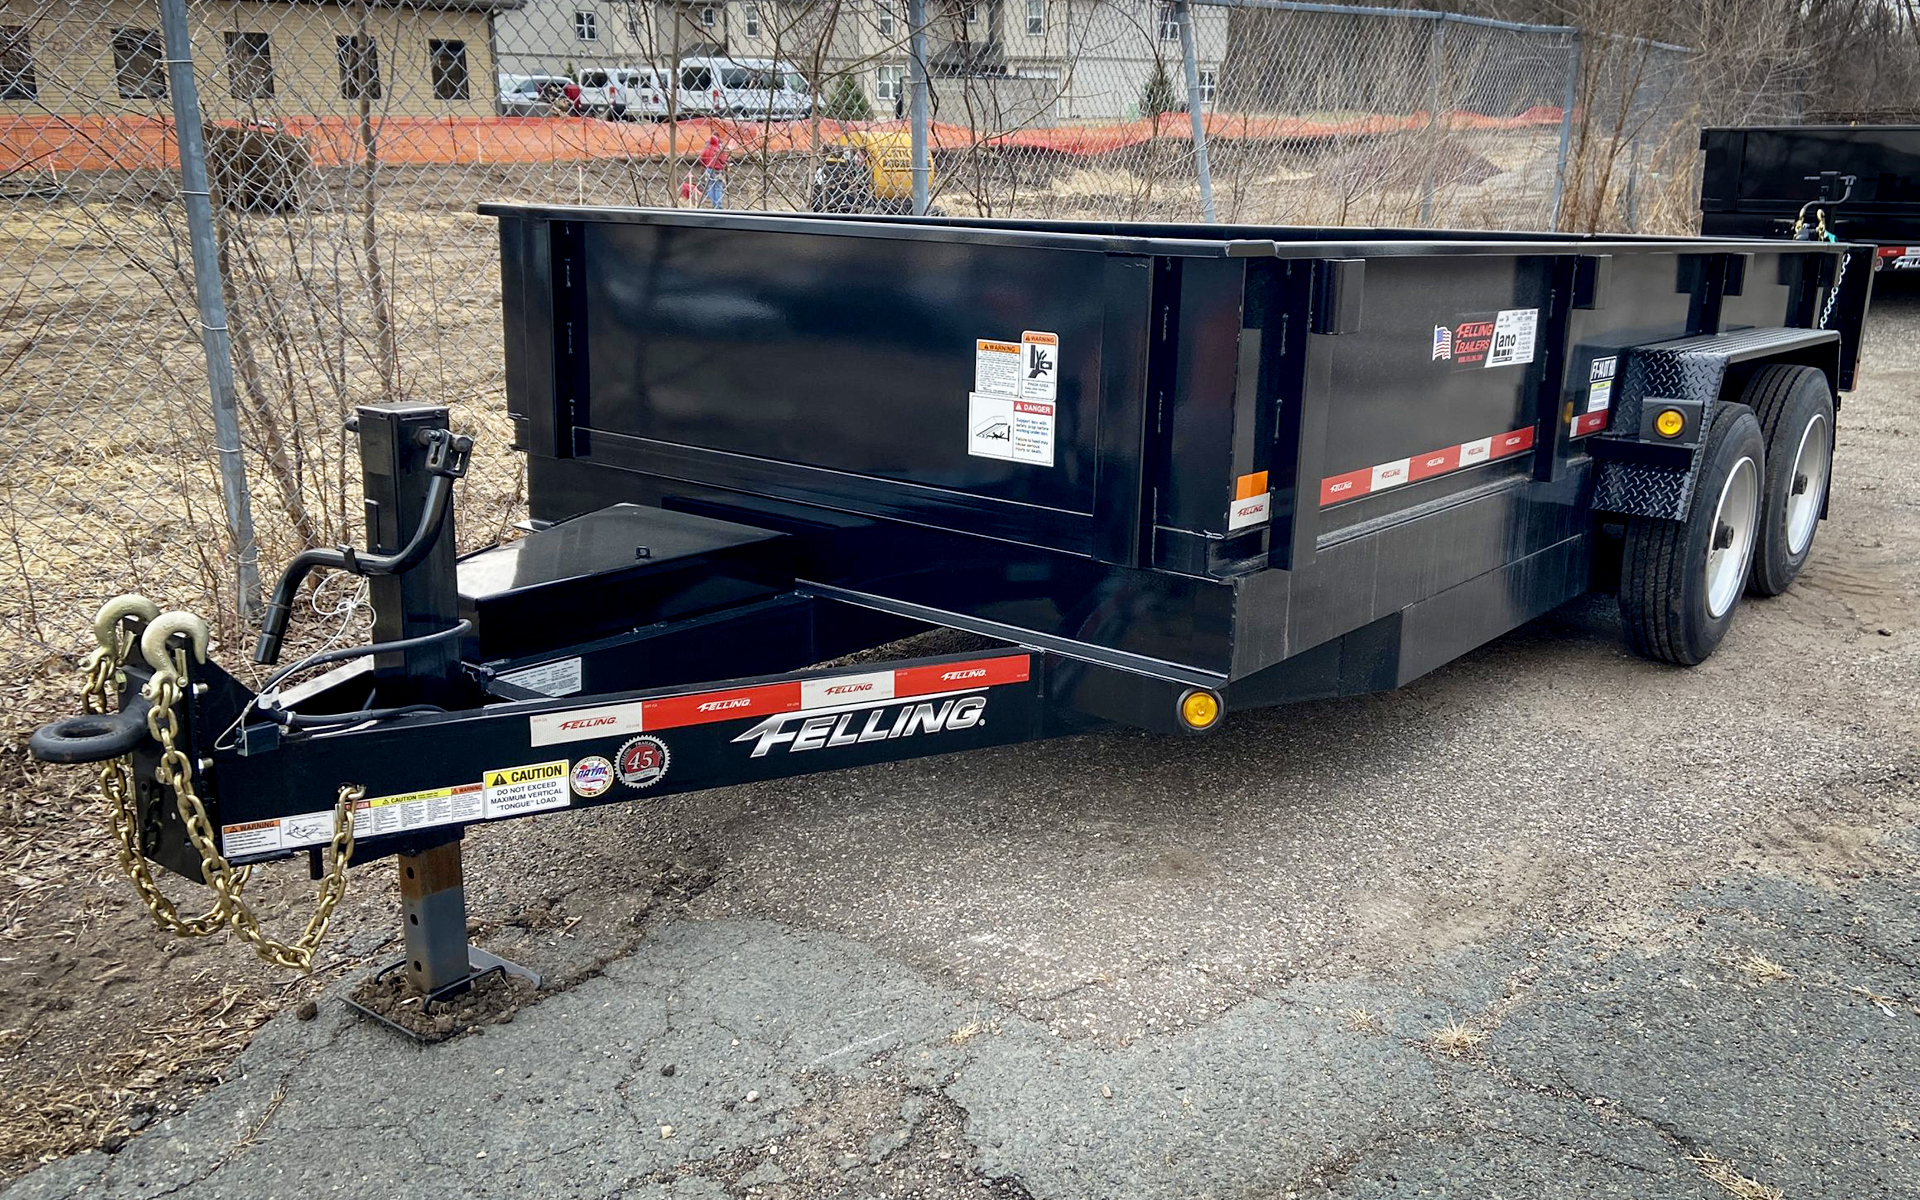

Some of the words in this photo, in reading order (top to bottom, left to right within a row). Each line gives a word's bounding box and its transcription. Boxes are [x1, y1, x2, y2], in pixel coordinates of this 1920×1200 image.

[1456, 321, 1494, 338] FELLING
[989, 344, 1016, 352] WARNING
[1454, 340, 1490, 354] TRAILERS
[1023, 404, 1051, 413] DANGER
[1380, 469, 1401, 479] FELLING
[1330, 481, 1353, 493] FELLING
[1237, 503, 1264, 517] FELLING
[940, 668, 987, 681] FELLING
[824, 682, 874, 696] FELLING
[696, 698, 751, 713] FELLING
[557, 715, 617, 731] FELLING
[627, 750, 654, 771] 45
[511, 764, 562, 783] CAUTION
[497, 788, 509, 796] DO
[510, 786, 525, 794] NOT
[527, 781, 557, 792] EXCEED
[390, 795, 417, 804] CAUTION
[491, 794, 526, 805] MAXIMUM
[528, 788, 563, 799] VERTICAL
[239, 820, 275, 832] WARNING
